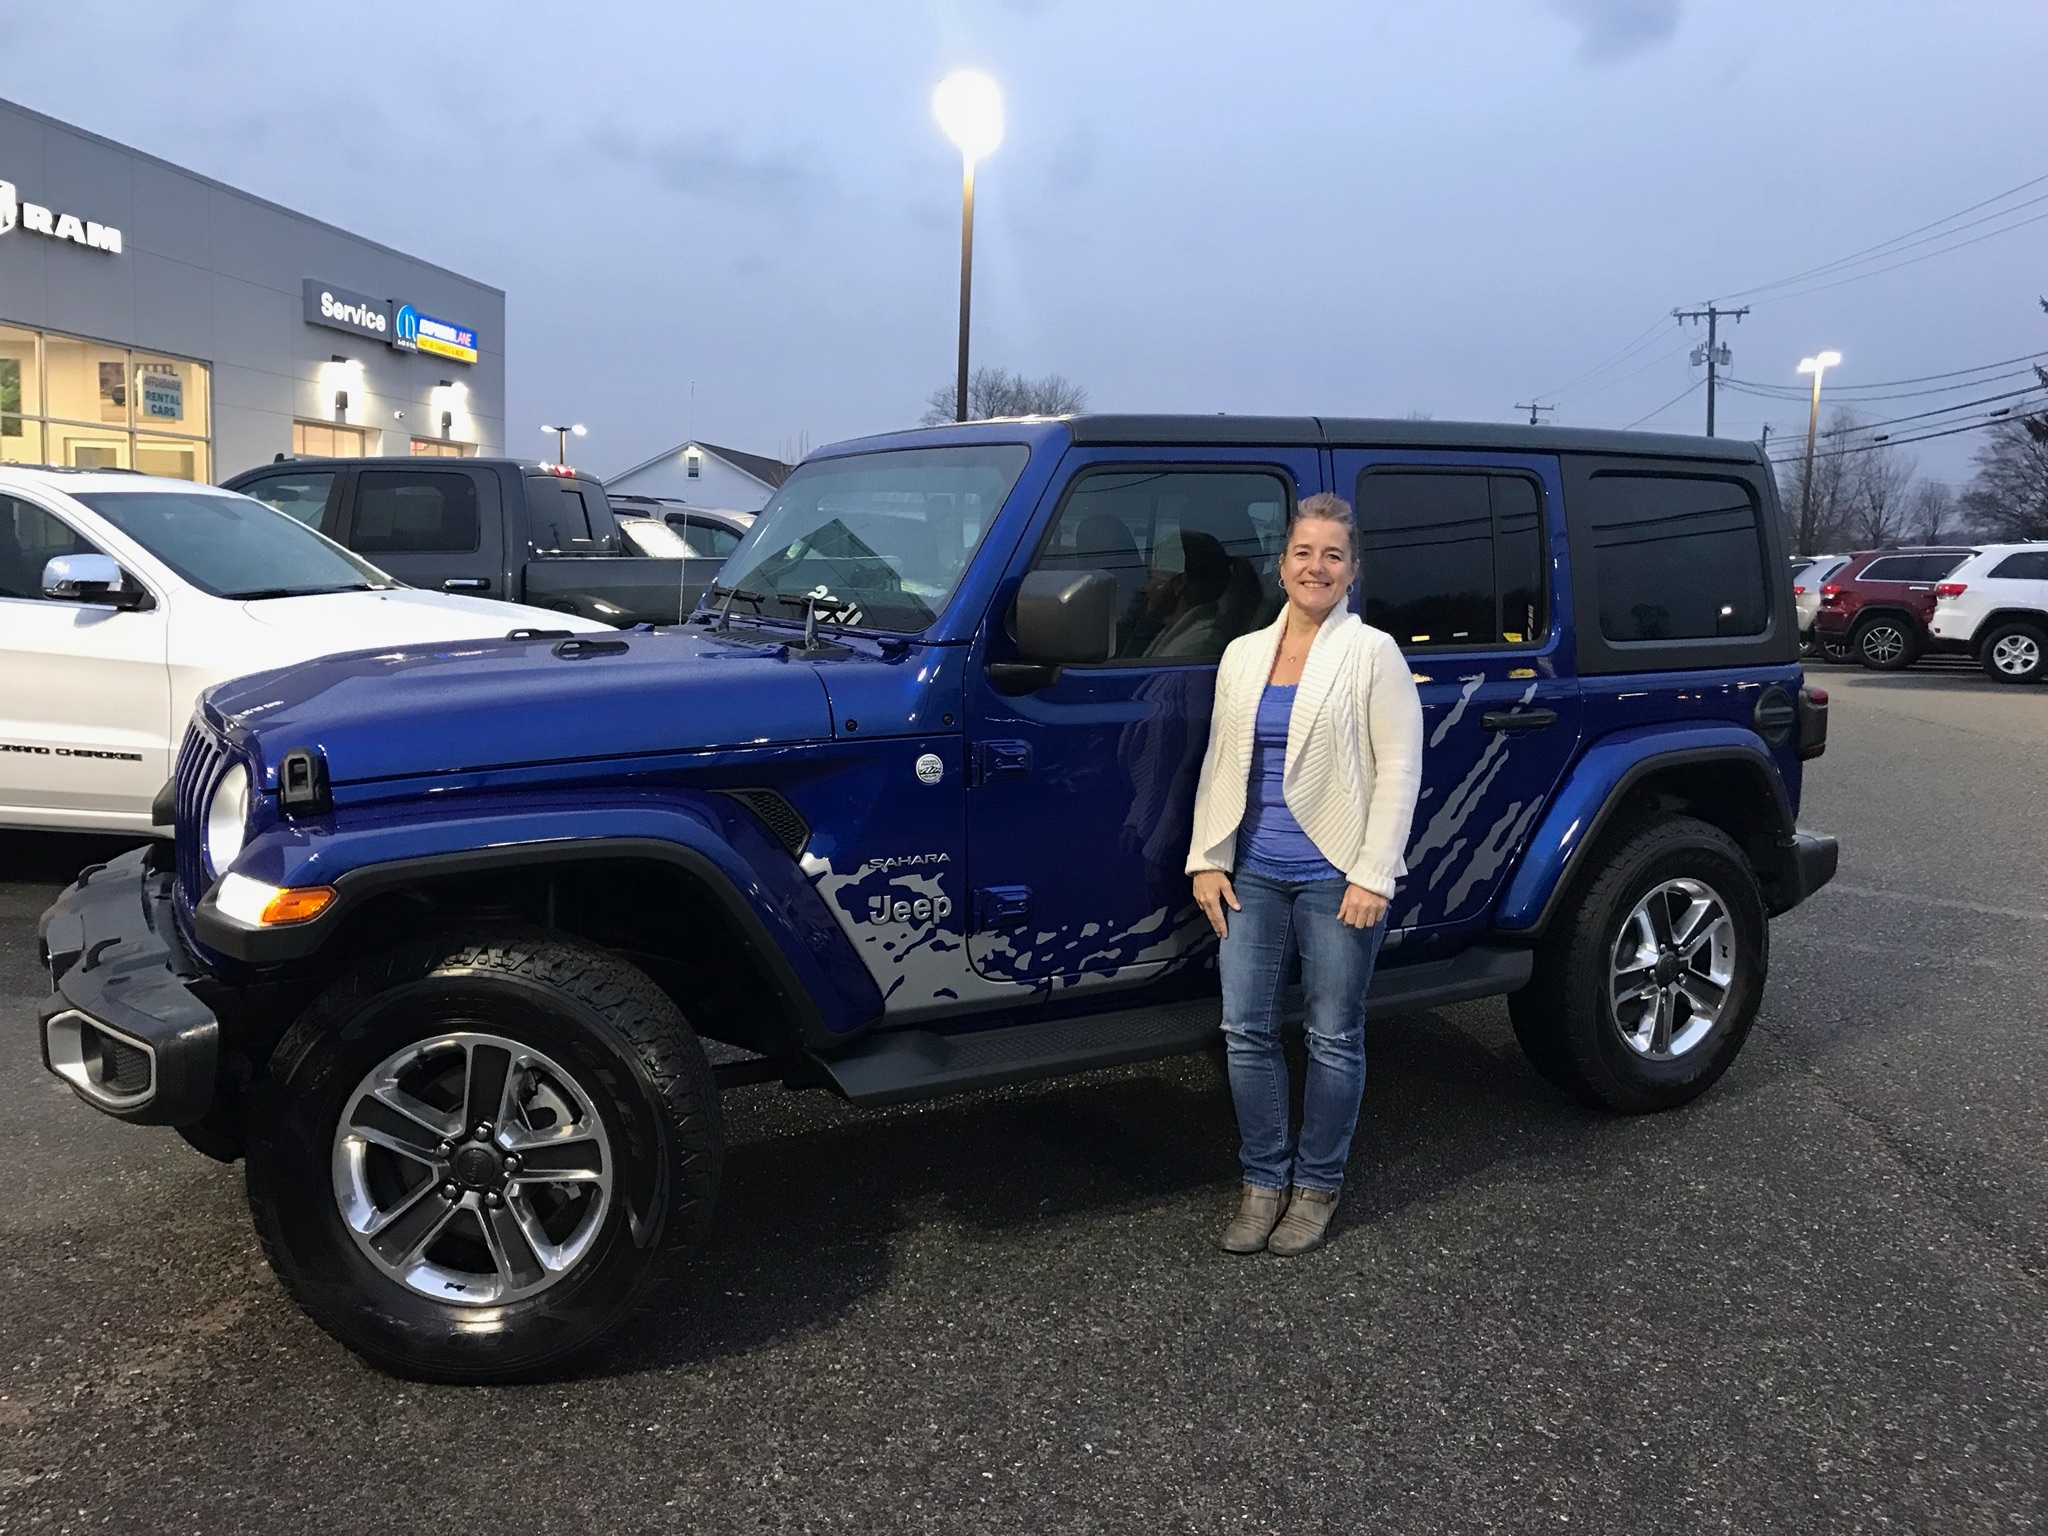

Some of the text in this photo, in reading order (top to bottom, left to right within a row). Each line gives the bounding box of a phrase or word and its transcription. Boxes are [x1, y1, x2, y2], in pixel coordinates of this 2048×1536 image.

[23, 202, 122, 254] RAM
[321, 291, 386, 332] Service
[145, 390, 182, 406] RENTAL
[151, 404, 176, 417] CARS
[55, 748, 143, 761] CHEROKEE
[869, 852, 951, 870] SAHARA
[869, 895, 952, 924] Jeep
